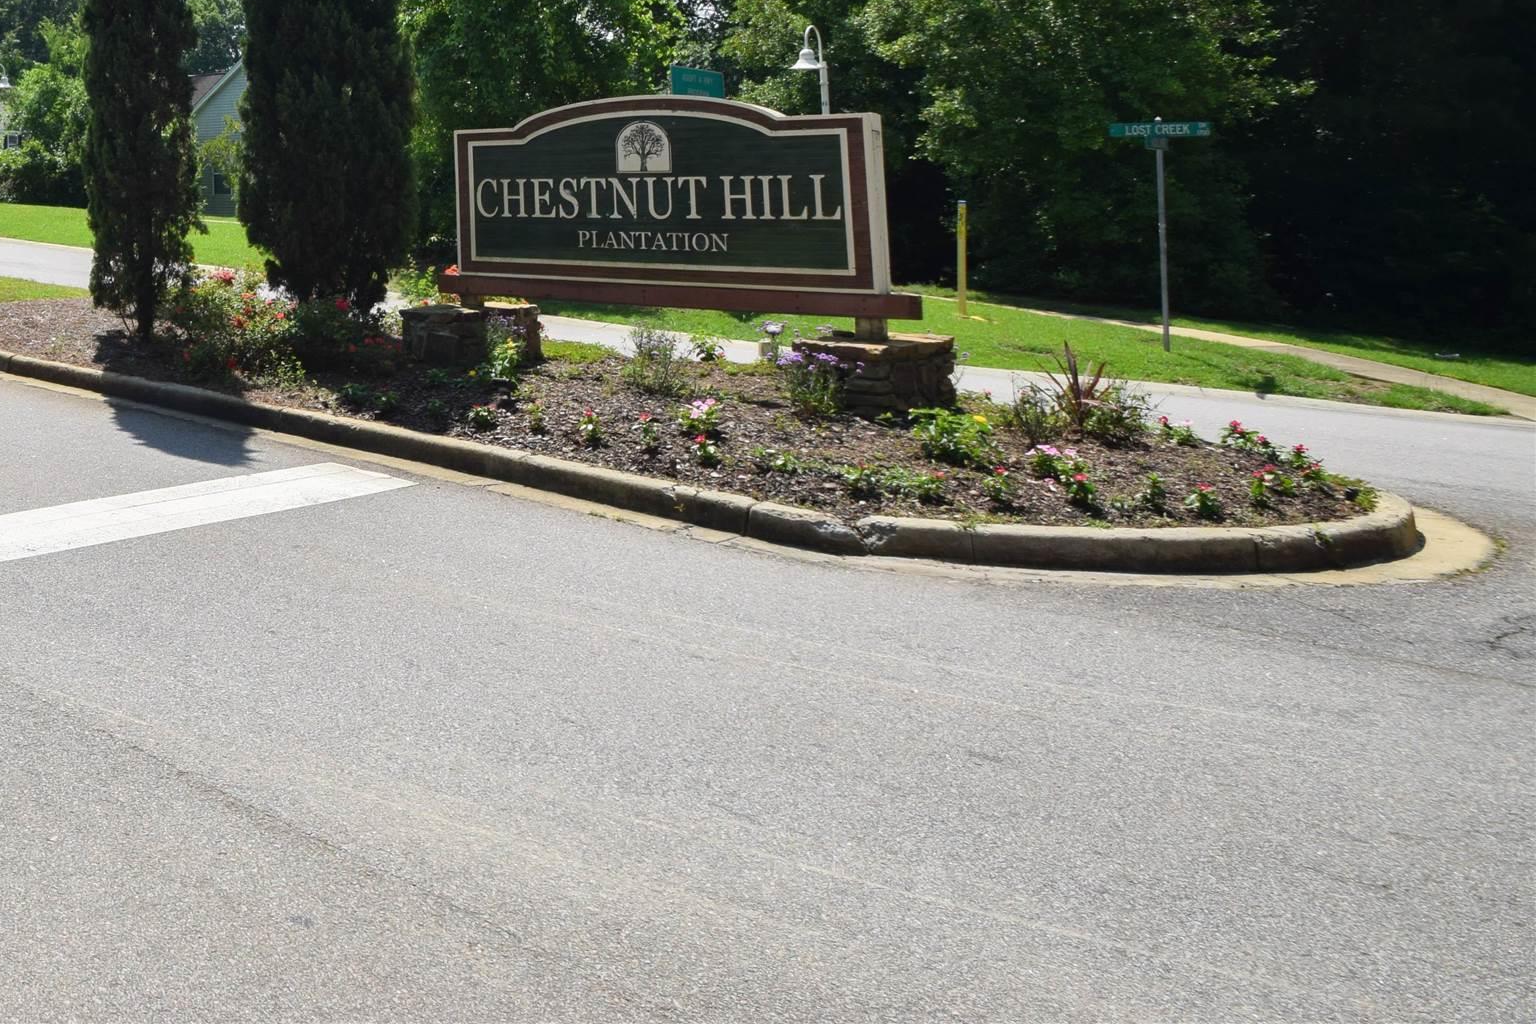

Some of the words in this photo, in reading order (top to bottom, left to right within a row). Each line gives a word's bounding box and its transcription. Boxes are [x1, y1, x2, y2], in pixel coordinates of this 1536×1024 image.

[1124, 124, 1152, 136] LOST
[1154, 123, 1190, 135] CREEK
[475, 175, 708, 220] CHESTNUT
[719, 174, 842, 221] HILL
[577, 230, 729, 253] PLANTATION
